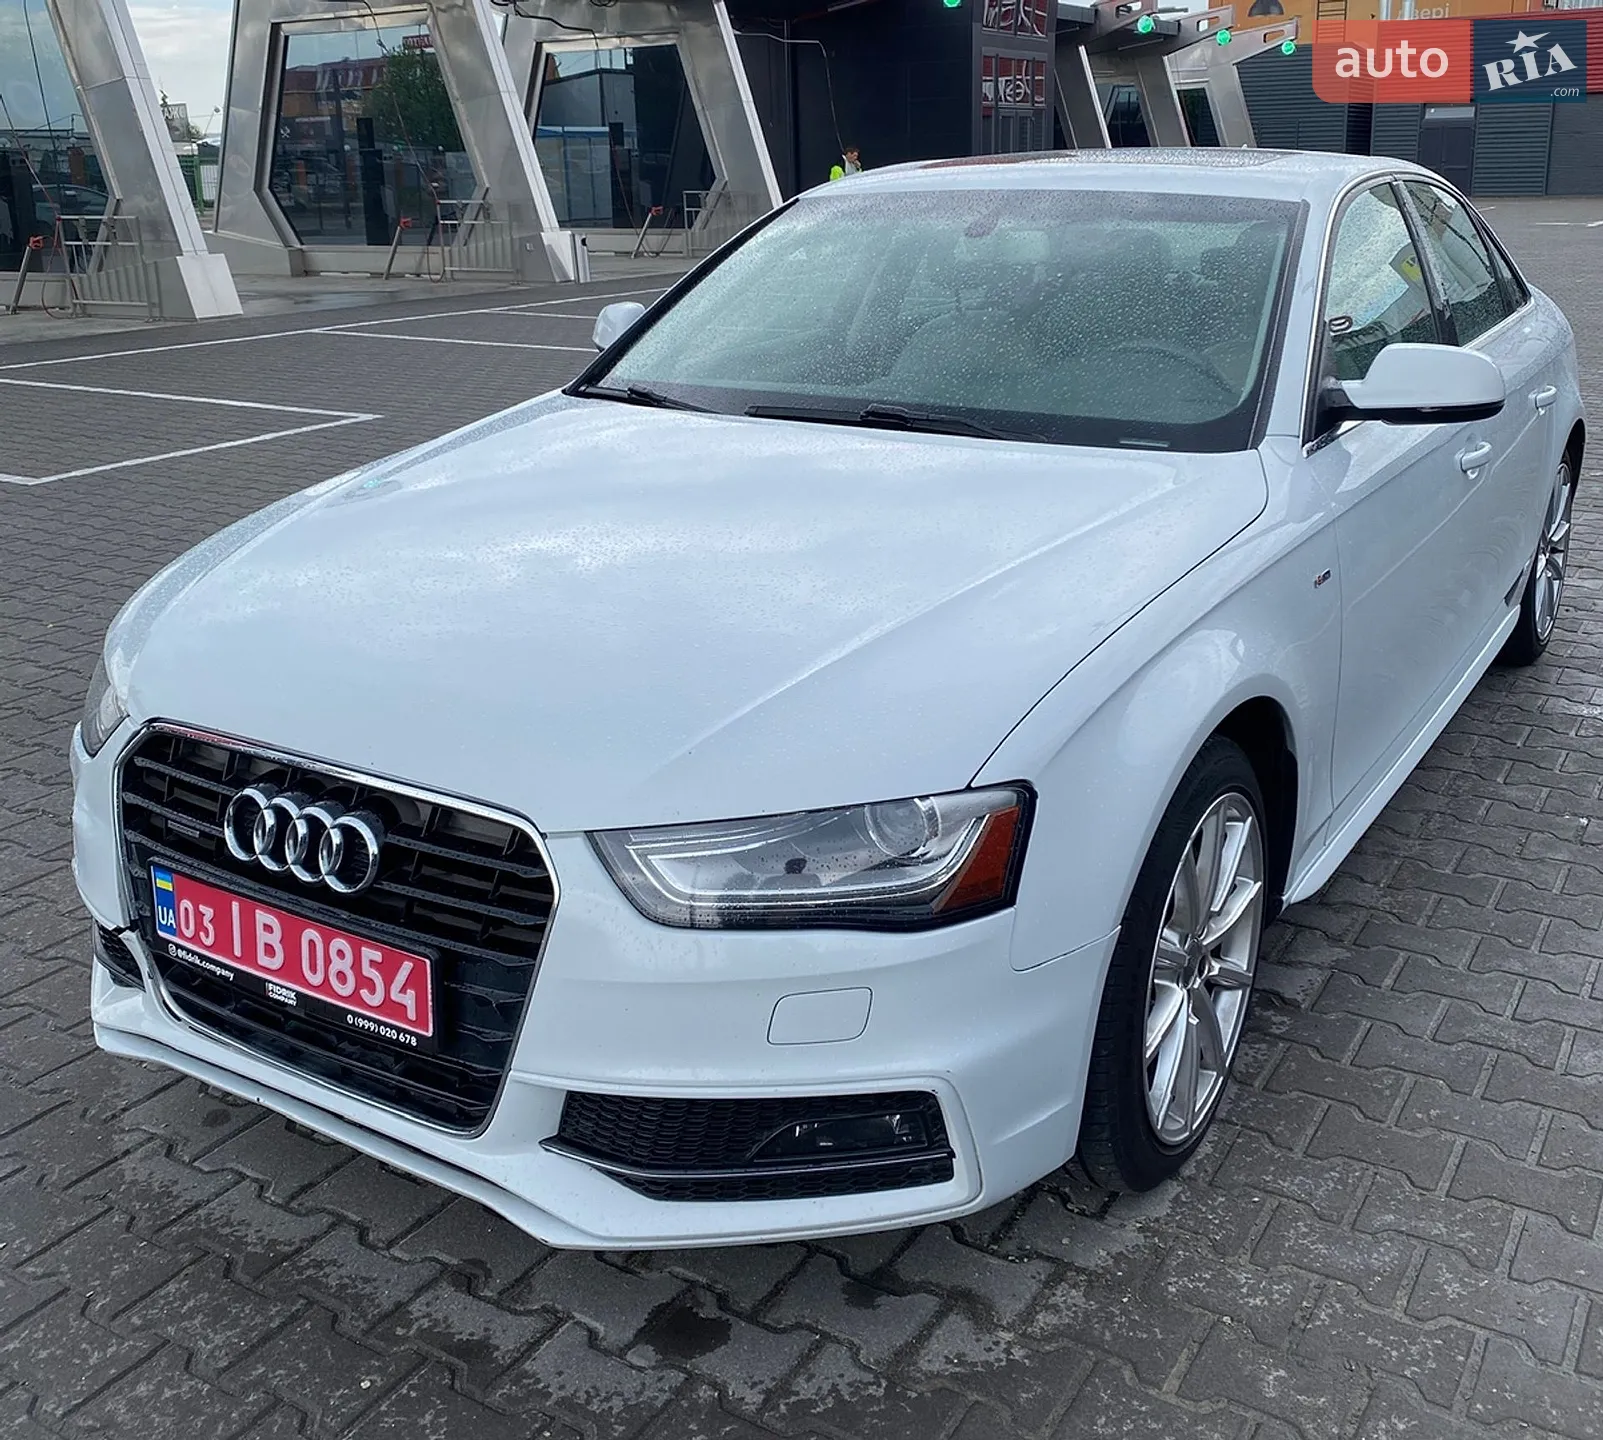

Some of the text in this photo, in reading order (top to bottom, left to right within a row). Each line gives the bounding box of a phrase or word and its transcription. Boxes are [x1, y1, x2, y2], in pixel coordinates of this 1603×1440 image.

[158, 905, 177, 929] UA
[179, 898, 215, 947] 03
[301, 928, 418, 1022] 0854
[346, 1014, 418, 1047] 0 (999) 020 678
